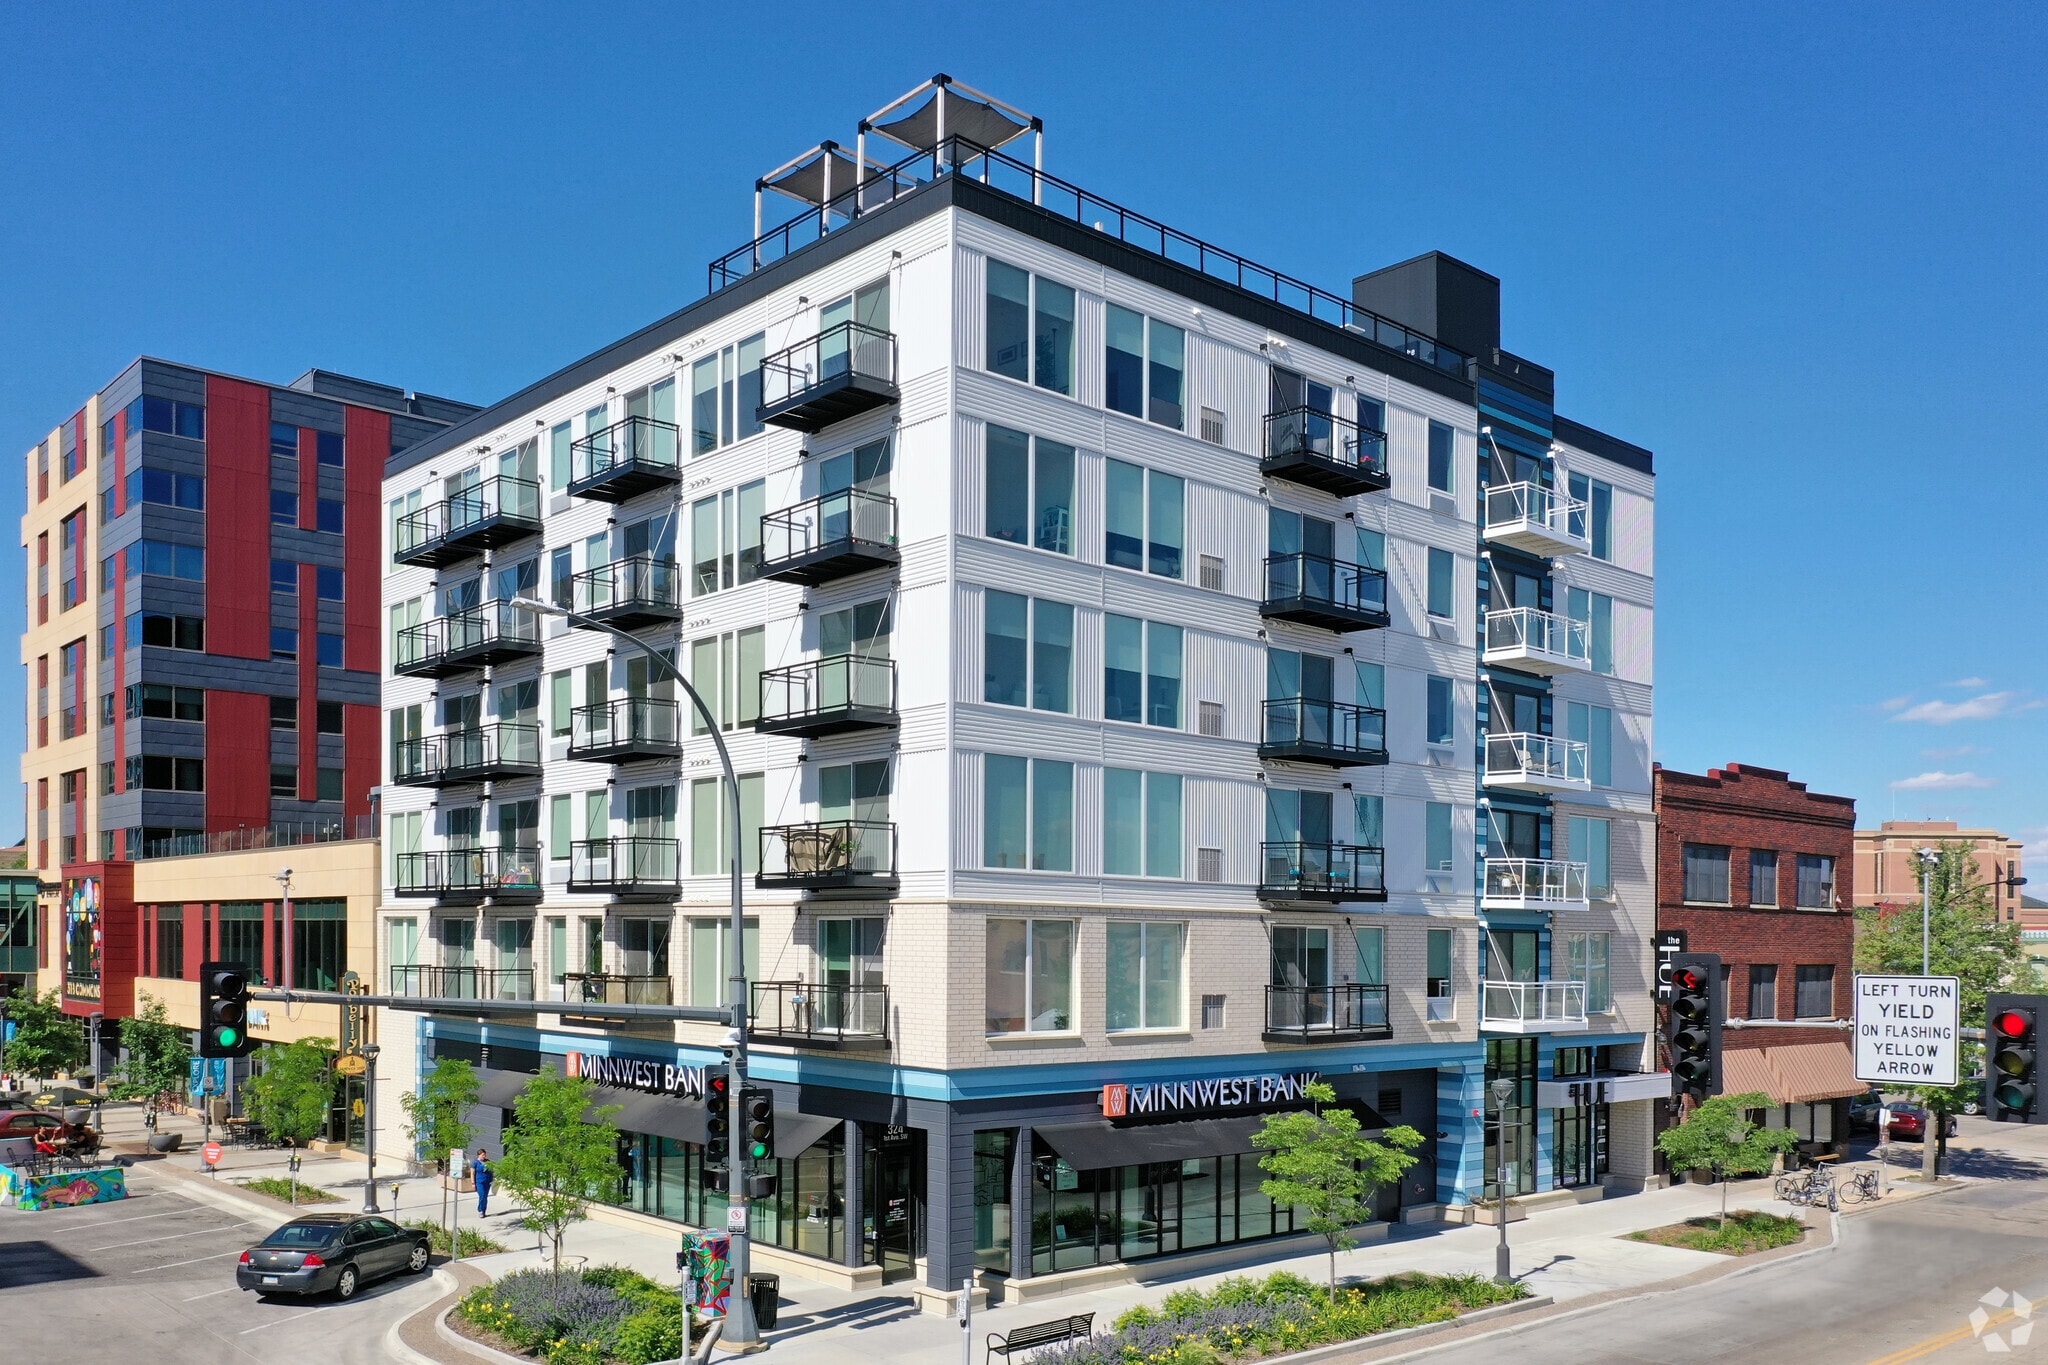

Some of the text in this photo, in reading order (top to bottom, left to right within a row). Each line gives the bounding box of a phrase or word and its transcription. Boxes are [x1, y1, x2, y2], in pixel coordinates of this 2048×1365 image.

[1667, 936, 1680, 945] the
[76, 982, 100, 998] COMMONS
[1862, 984, 1951, 998] LEFT TURN
[1878, 1003, 1934, 1019] YIELD
[1861, 1024, 1951, 1040] ON FLASHING
[1873, 1042, 1939, 1058] YELLOW
[579, 1053, 706, 1095] MINNWEST BAN
[1877, 1060, 1934, 1076] ARROW
[1129, 1078, 1255, 1114] MINNWEST
[887, 1124, 904, 1135] 324
[1597, 1125, 1606, 1165] HUE
